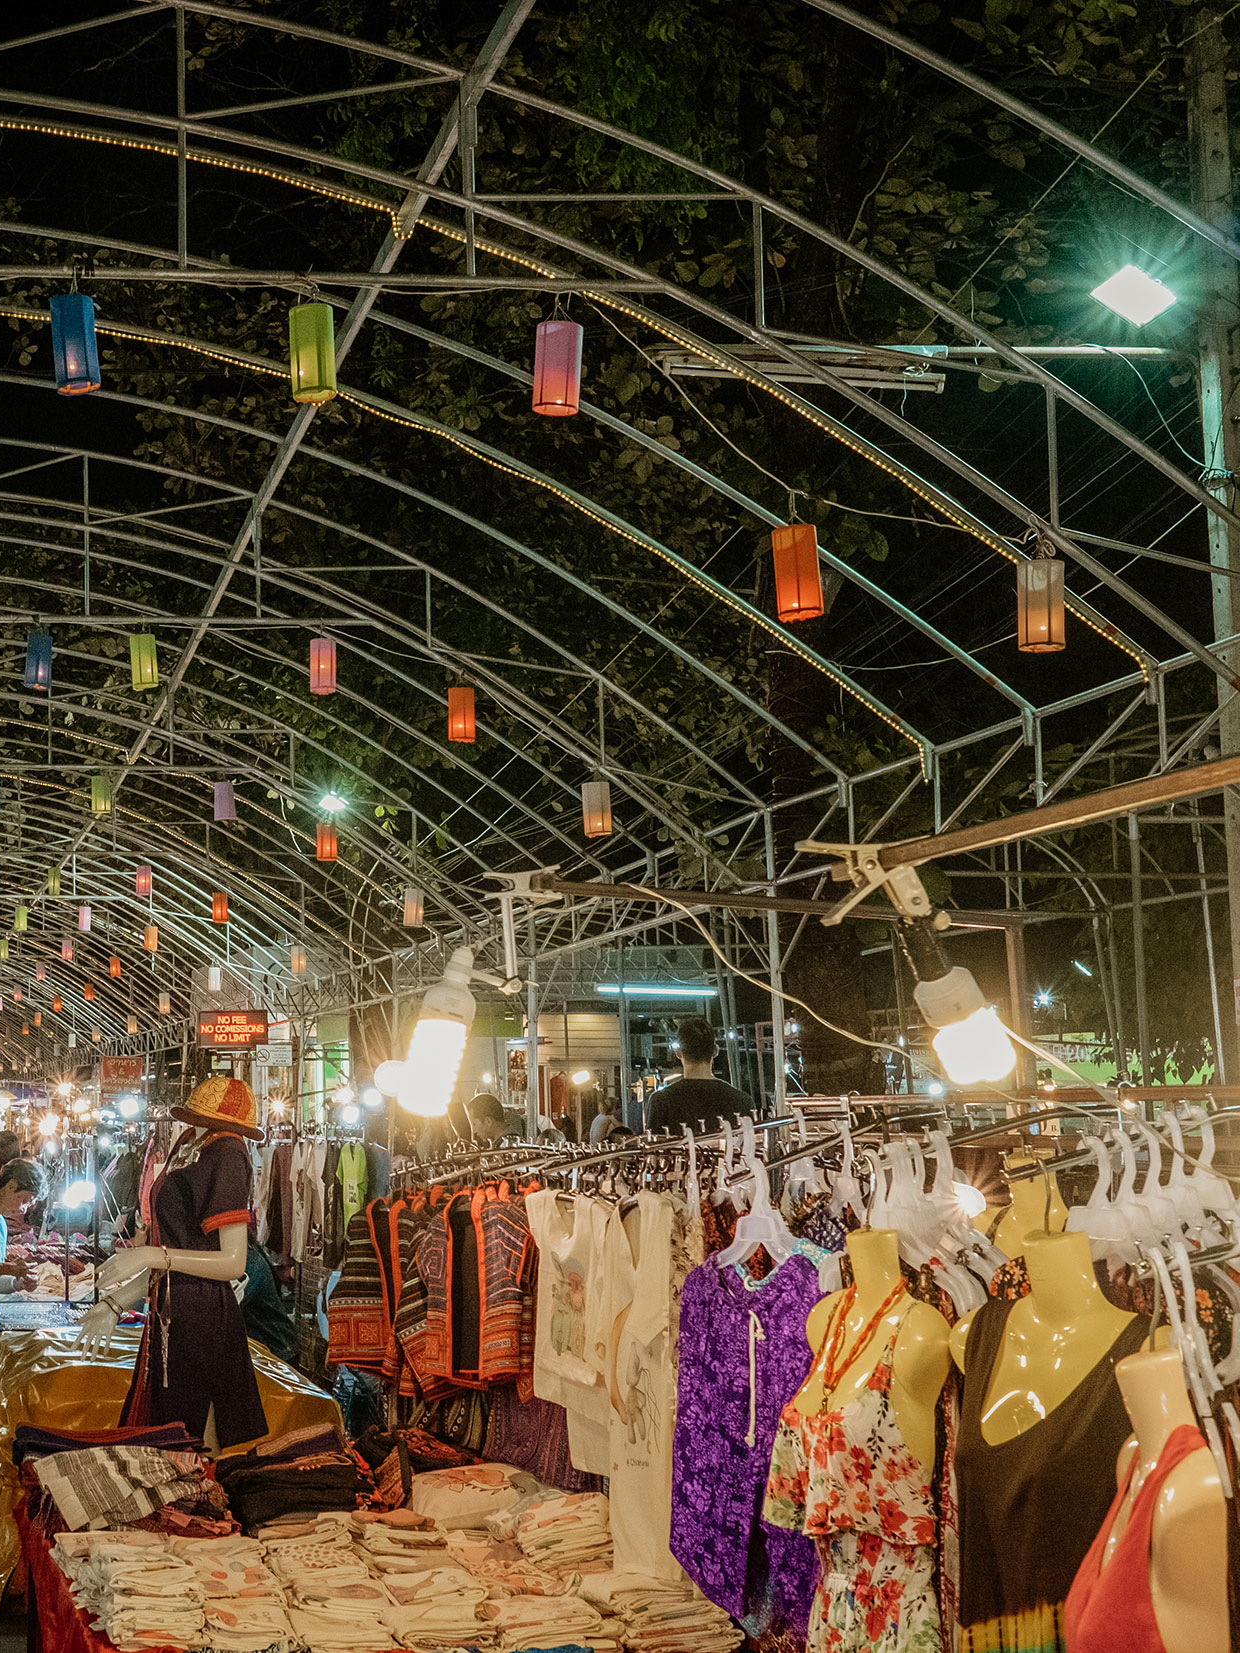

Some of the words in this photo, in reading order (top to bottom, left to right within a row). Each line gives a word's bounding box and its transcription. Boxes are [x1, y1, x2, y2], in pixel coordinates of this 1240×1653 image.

[217, 1016, 230, 1024] NO
[231, 1016, 247, 1024] FEE
[201, 1025, 214, 1033] NO
[215, 1025, 265, 1033] COMISSIONS
[214, 1033, 227, 1042] NO
[229, 1033, 251, 1042] LIMIT
